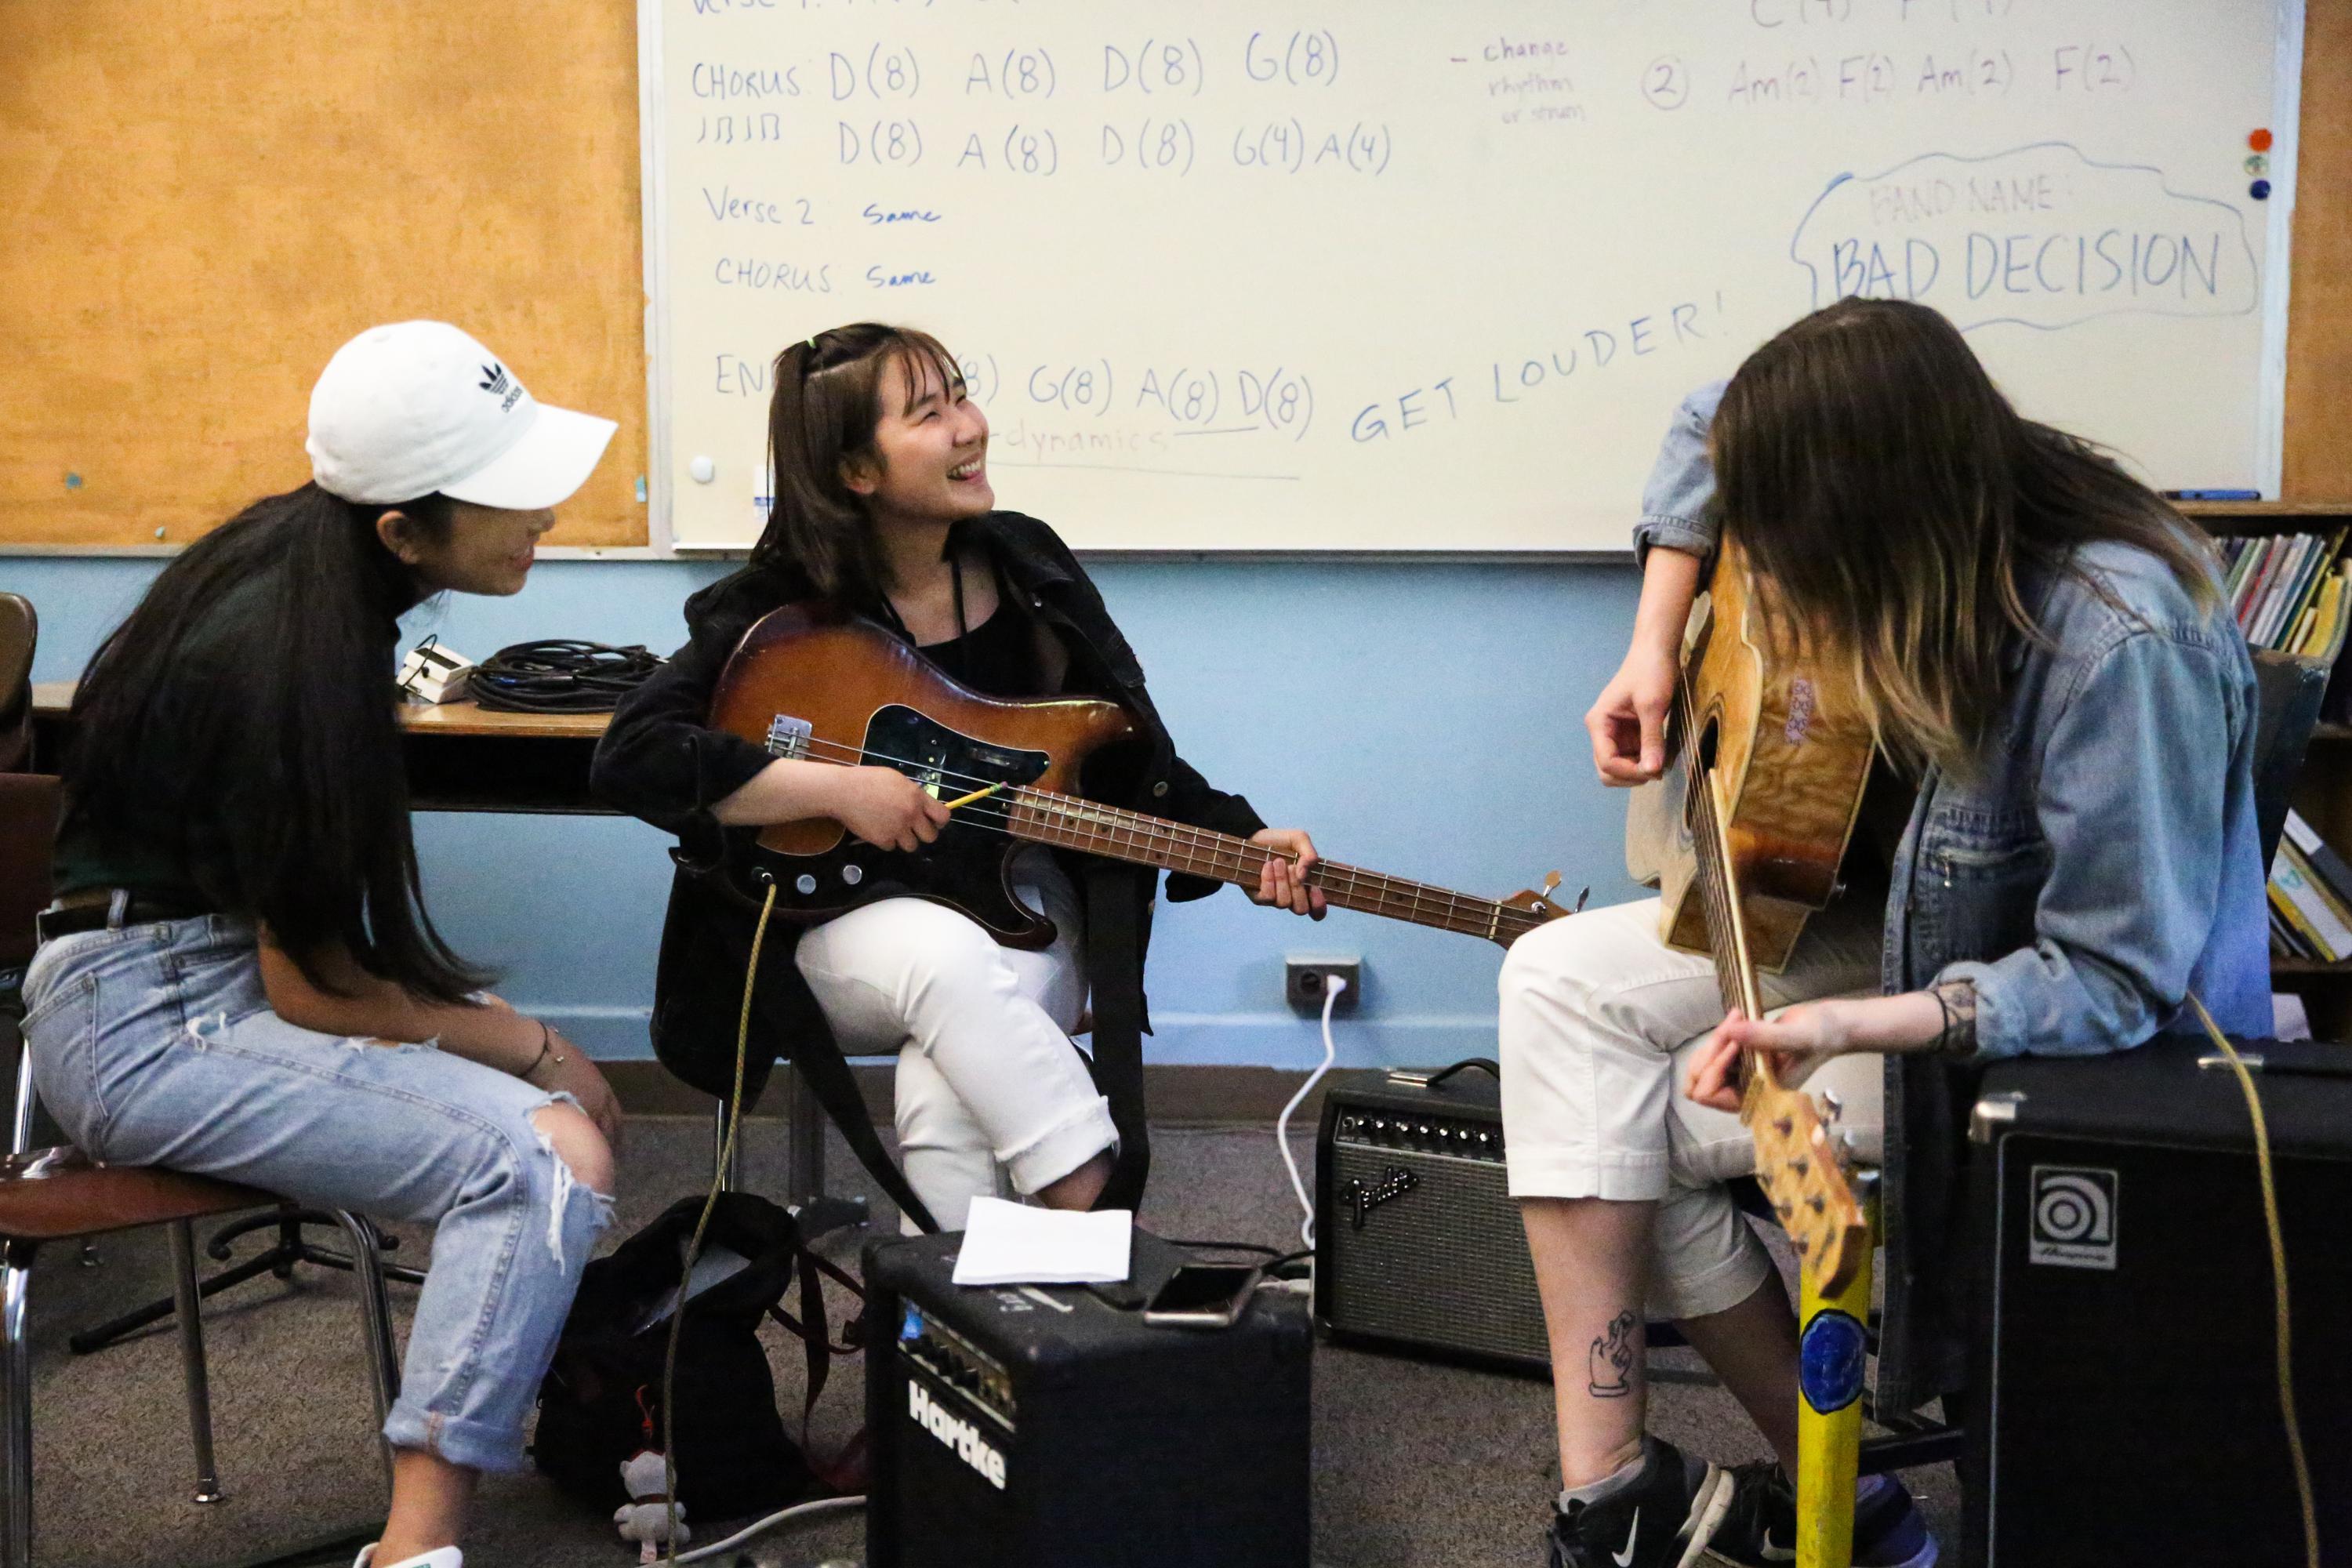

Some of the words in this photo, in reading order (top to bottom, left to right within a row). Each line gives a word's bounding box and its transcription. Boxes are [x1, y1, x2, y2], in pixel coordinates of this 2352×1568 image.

[702, 186, 781, 224] Verse
[1833, 238, 1941, 303] BAD
[1966, 229, 2220, 301] DECISION
[716, 352, 772, 397] EN
[1352, 377, 1457, 442] GET
[909, 1379, 1007, 1490] Hartke
